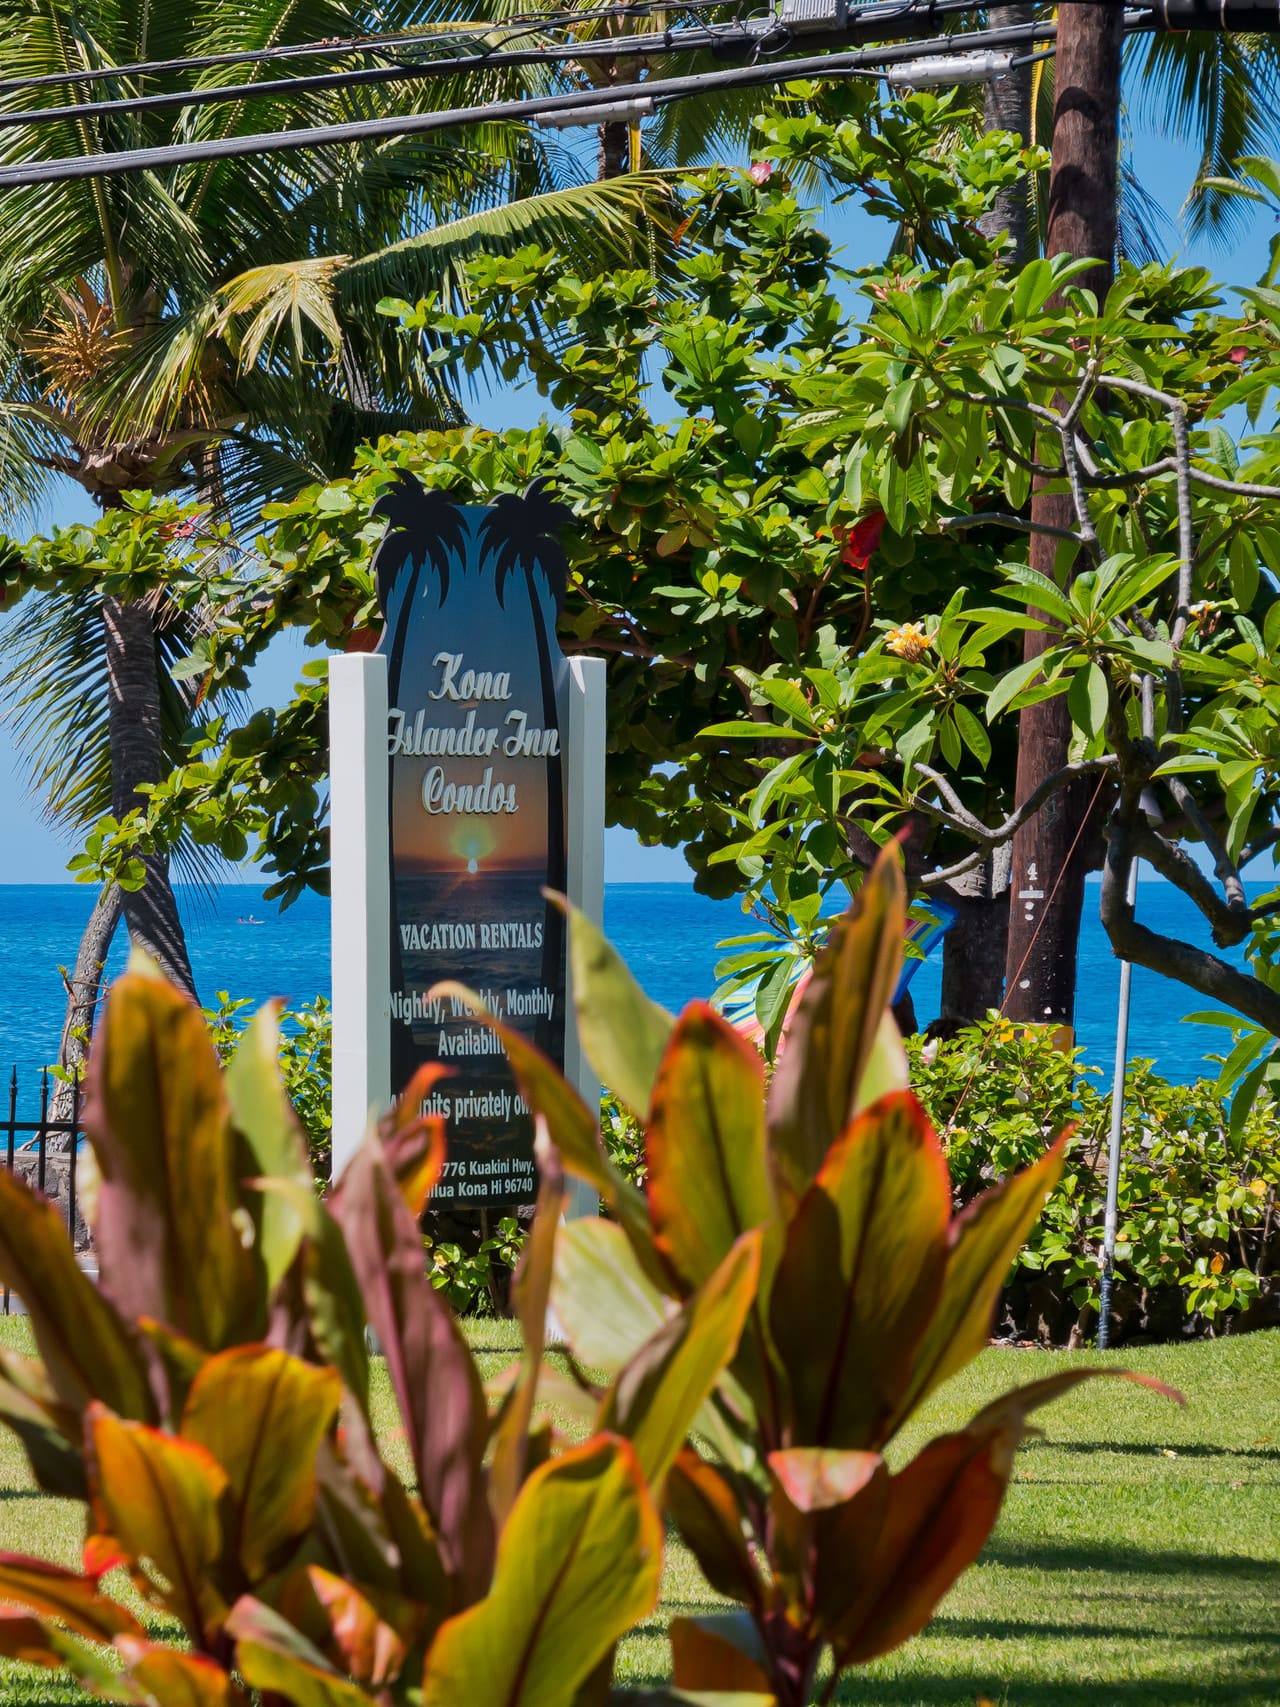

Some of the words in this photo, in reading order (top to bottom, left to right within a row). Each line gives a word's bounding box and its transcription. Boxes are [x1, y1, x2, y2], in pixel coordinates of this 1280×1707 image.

[428, 652, 512, 701] Kona
[386, 708, 498, 757] Islander
[502, 709, 560, 757] Inn
[422, 765, 519, 814] Condos
[400, 923, 476, 950] VACATION
[480, 922, 543, 948] RENTALS
[450, 987, 503, 1024] Wekly,
[506, 986, 554, 1020] Monthly
[417, 1091, 451, 1120] nits
[455, 1088, 511, 1125] privately
[469, 1158, 509, 1176] Kuakini
[512, 1158, 535, 1176] Hwy.
[458, 1180, 488, 1197] Kona
[491, 1178, 502, 1195] Hi
[504, 1177, 533, 1194] 96740
